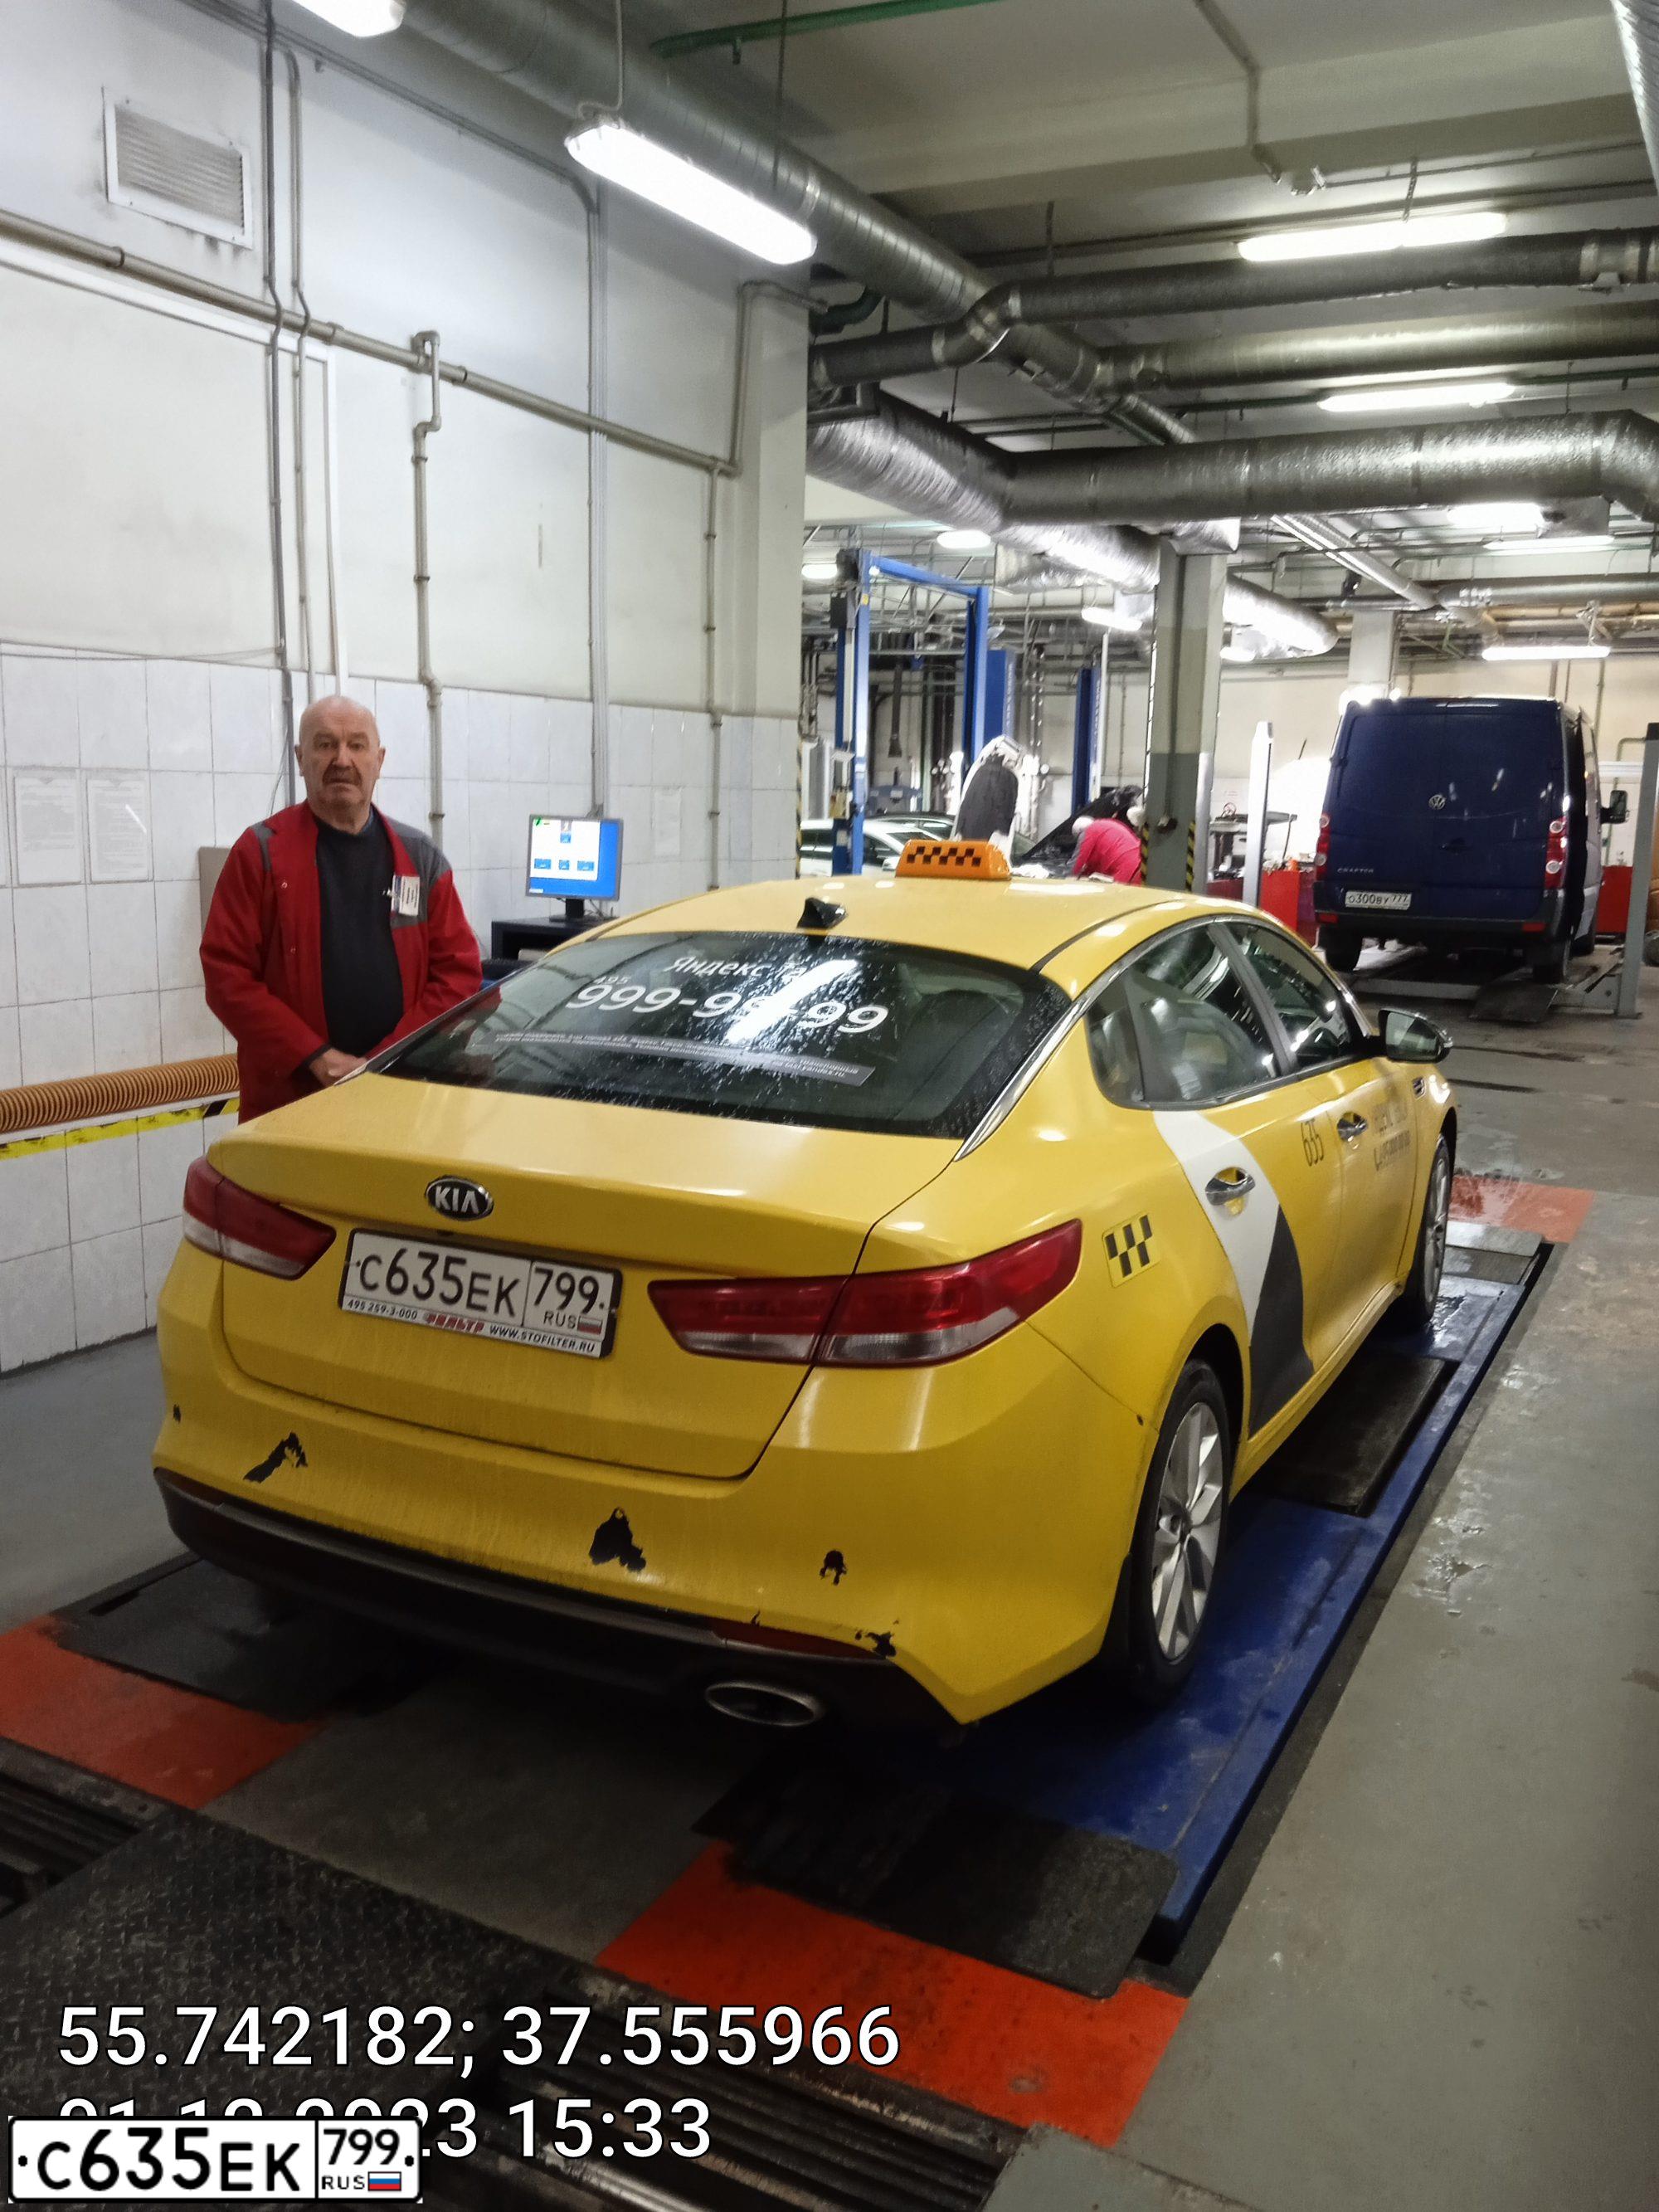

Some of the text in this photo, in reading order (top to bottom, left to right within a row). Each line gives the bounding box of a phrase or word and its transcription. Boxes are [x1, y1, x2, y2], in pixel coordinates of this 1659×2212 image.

[435, 1185, 479, 1215] KIA
[359, 1247, 600, 1318] С635ЕК 799
[347, 1298, 366, 1311] 495
[489, 1324, 596, 1353] WWW.STOFILTER.RU
[542, 1310, 577, 1330] RUS
